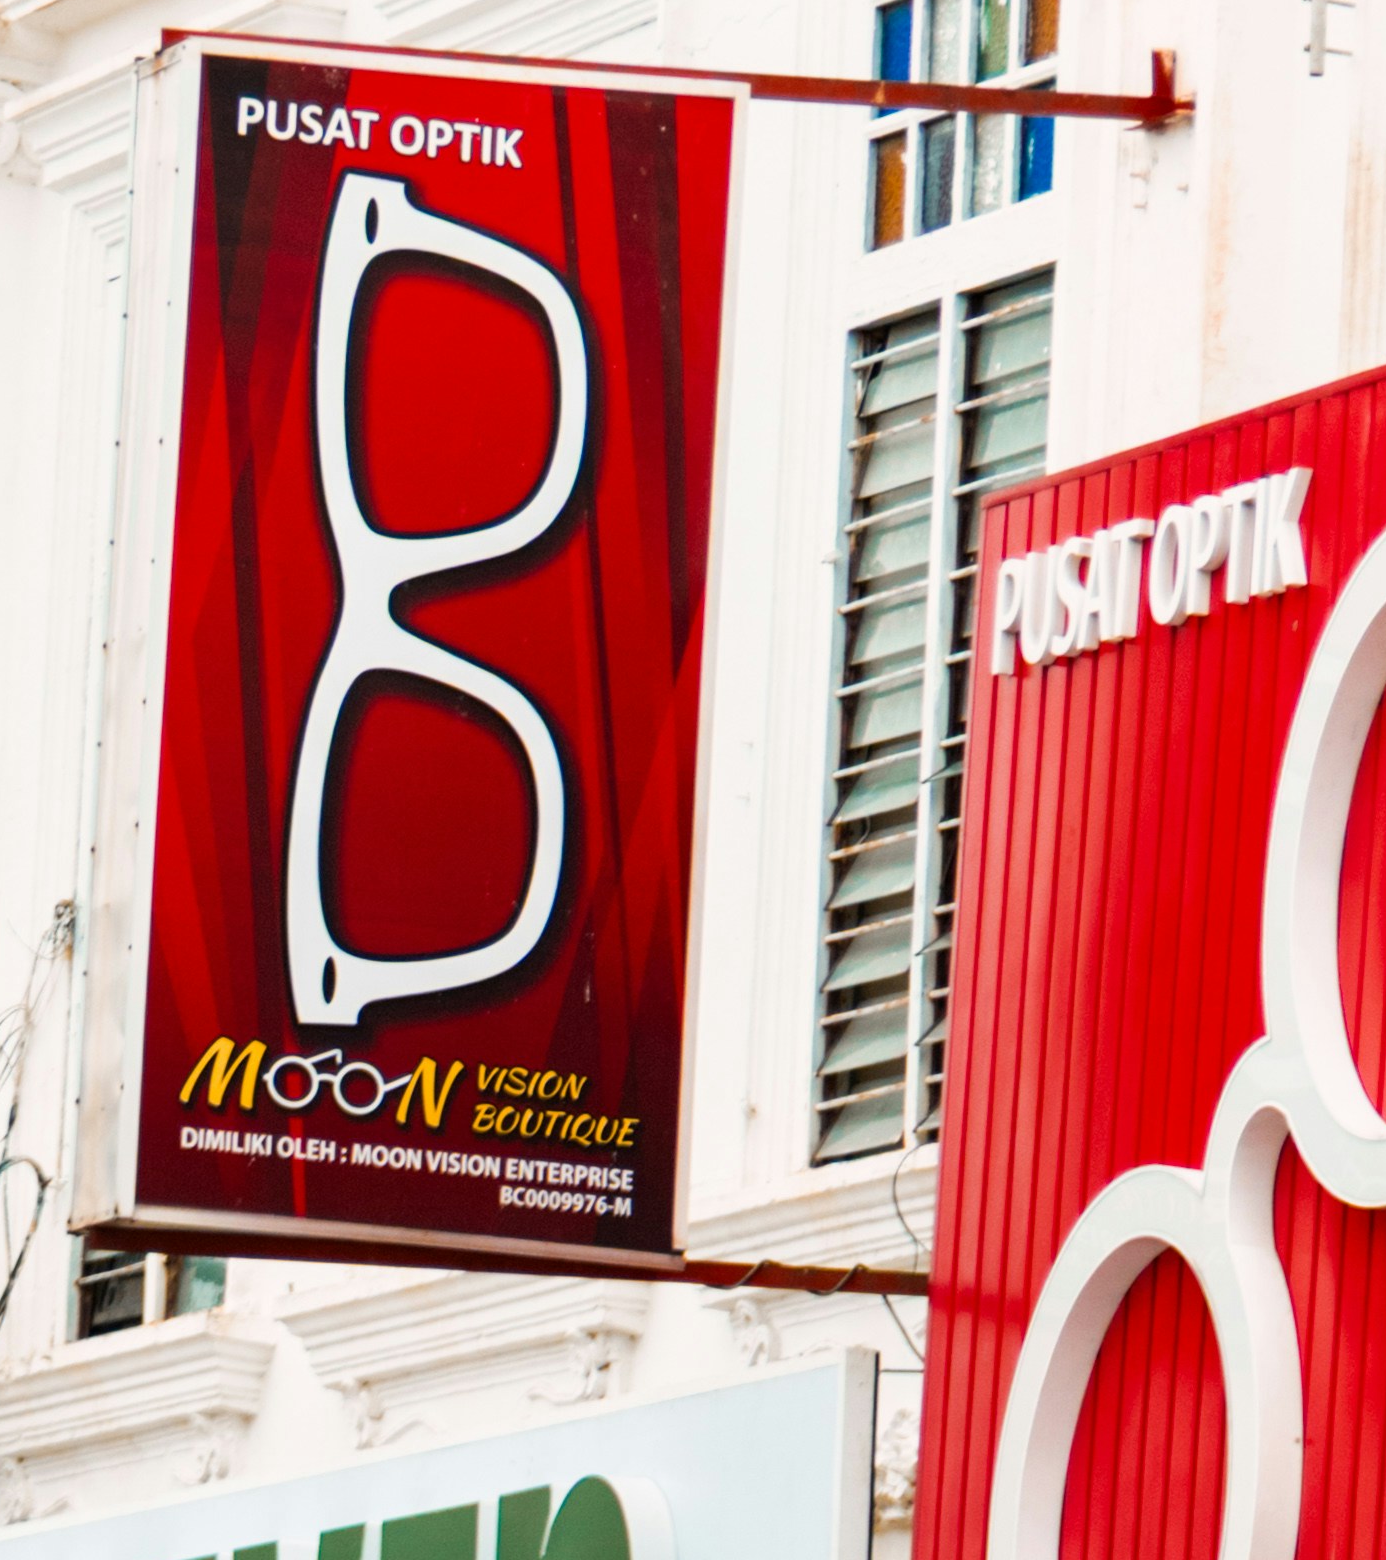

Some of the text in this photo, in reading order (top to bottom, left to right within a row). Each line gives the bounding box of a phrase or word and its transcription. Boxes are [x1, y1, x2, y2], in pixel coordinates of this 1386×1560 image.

[238, 96, 523, 168] PUSAT OPTIK
[992, 466, 1313, 676] PUSAT OPTIK
[477, 1063, 587, 1102] VISION
[472, 1103, 639, 1147] BOUTIQUE
[180, 1126, 272, 1156] DIMILIKI
[277, 1135, 336, 1163] OLEH
[351, 1144, 422, 1171] MOON
[426, 1150, 501, 1179] VISION
[505, 1158, 634, 1192] ENTERPRISE
[500, 1185, 633, 1217] BC0009976-M
